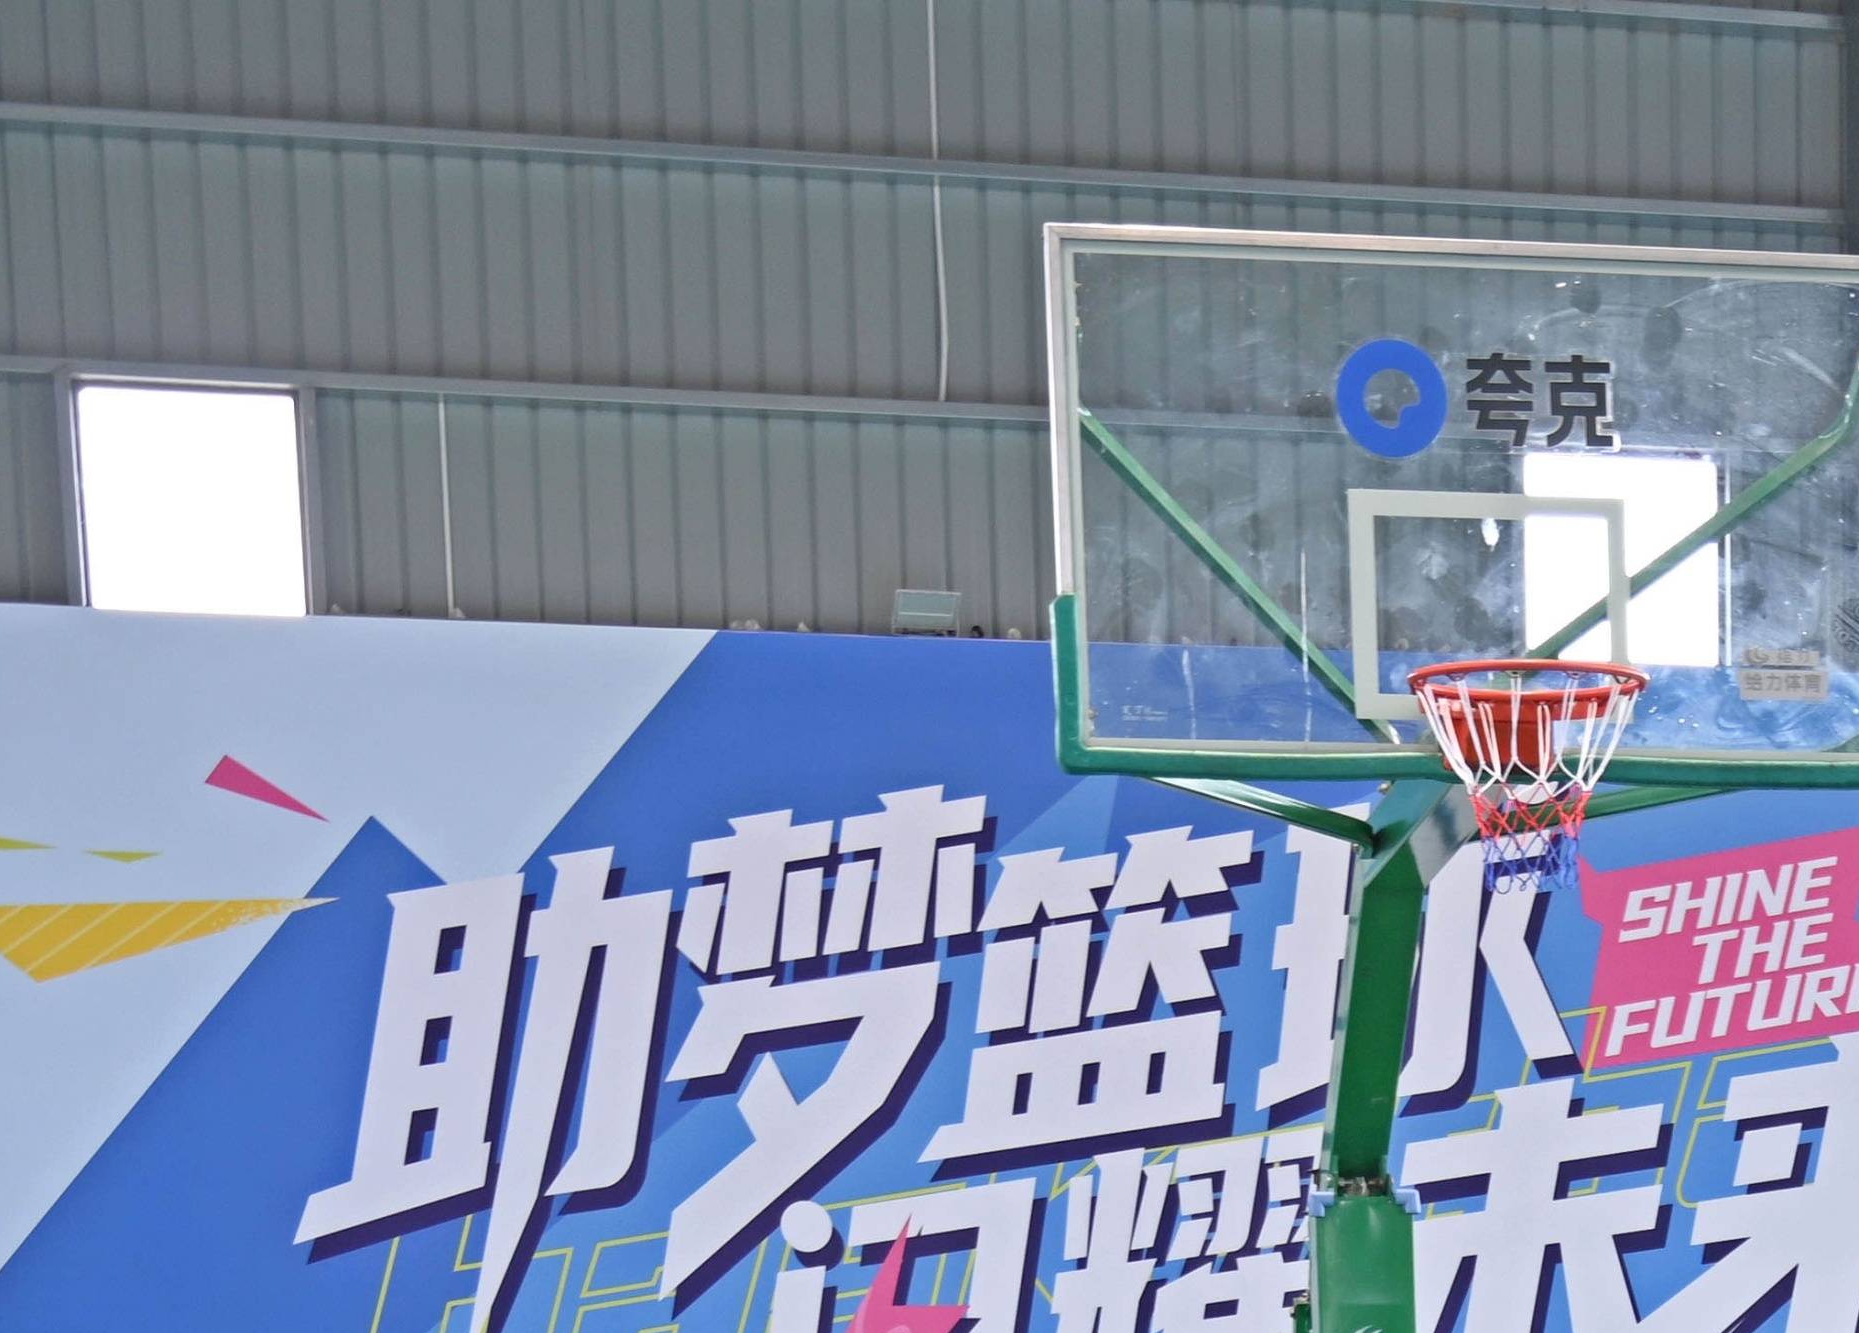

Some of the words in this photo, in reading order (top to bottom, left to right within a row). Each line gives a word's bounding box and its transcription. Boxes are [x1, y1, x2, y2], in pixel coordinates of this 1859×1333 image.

[1465, 352, 1621, 448] 夸克
[1618, 855, 1838, 943] SHINE
[1693, 913, 1833, 984] THE
